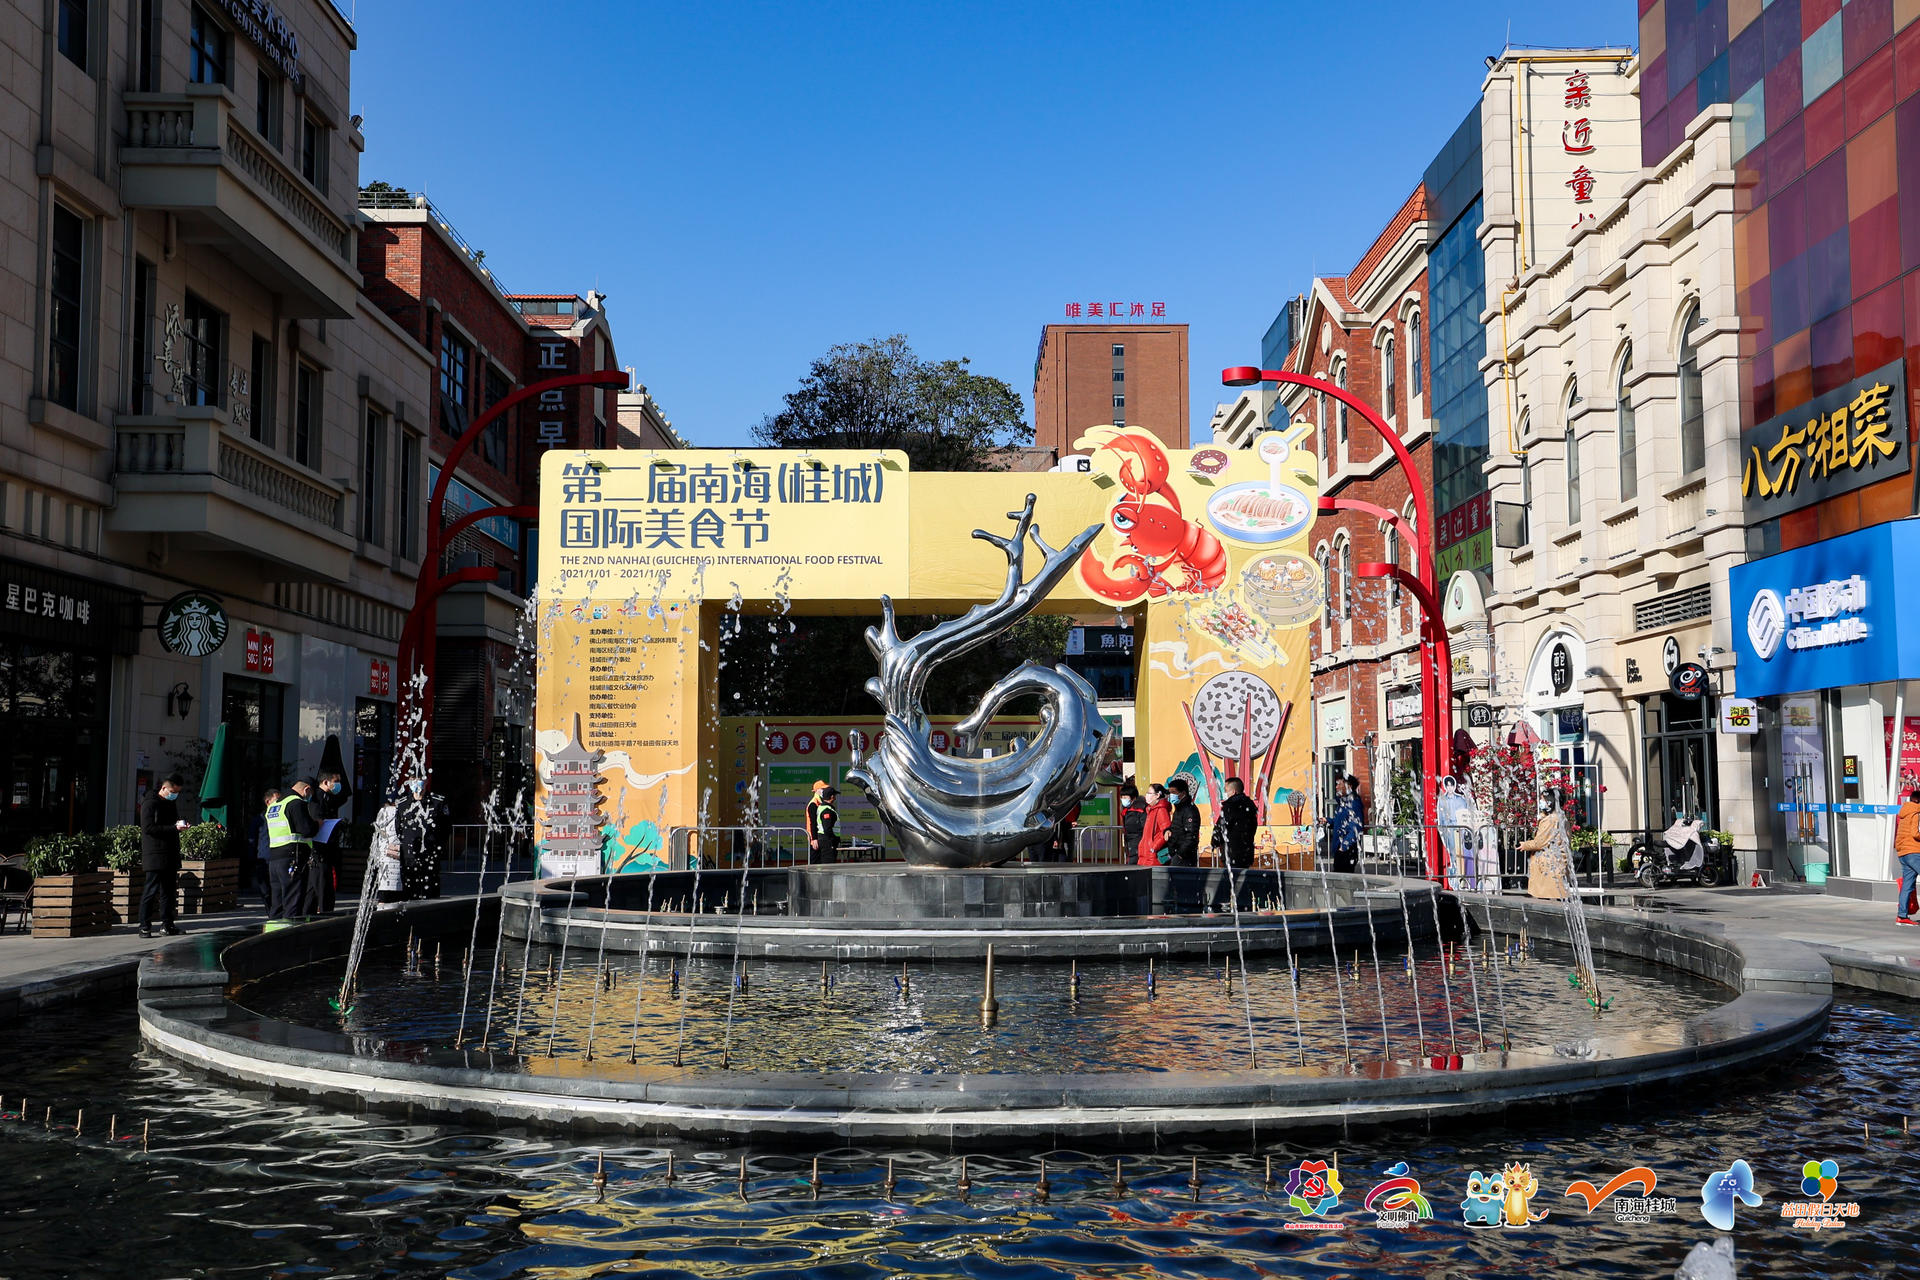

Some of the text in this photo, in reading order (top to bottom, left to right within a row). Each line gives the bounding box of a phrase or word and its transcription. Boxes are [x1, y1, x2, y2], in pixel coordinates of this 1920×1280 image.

[232, 1, 302, 85] CENTER FOR KIDS
[240, 0, 300, 61] 美术中心
[1065, 302, 1167, 318] 唯美汇沐足
[1742, 381, 1897, 498] 八方湘菜
[562, 463, 884, 503] 第二届南海(桂城)
[560, 508, 770, 549] 国际美食节
[560, 555, 883, 567] THE 2ND NANHAI (GUICHENG) INTERNATIONAL FOOD FESTIVAL
[560, 568, 611, 579] 2021/1/01
[620, 568, 672, 579] 2021/1/05
[6, 583, 91, 625] 星巴克咖啡
[1785, 575, 1867, 623] 中国移动
[1731, 716, 1751, 727] 100
